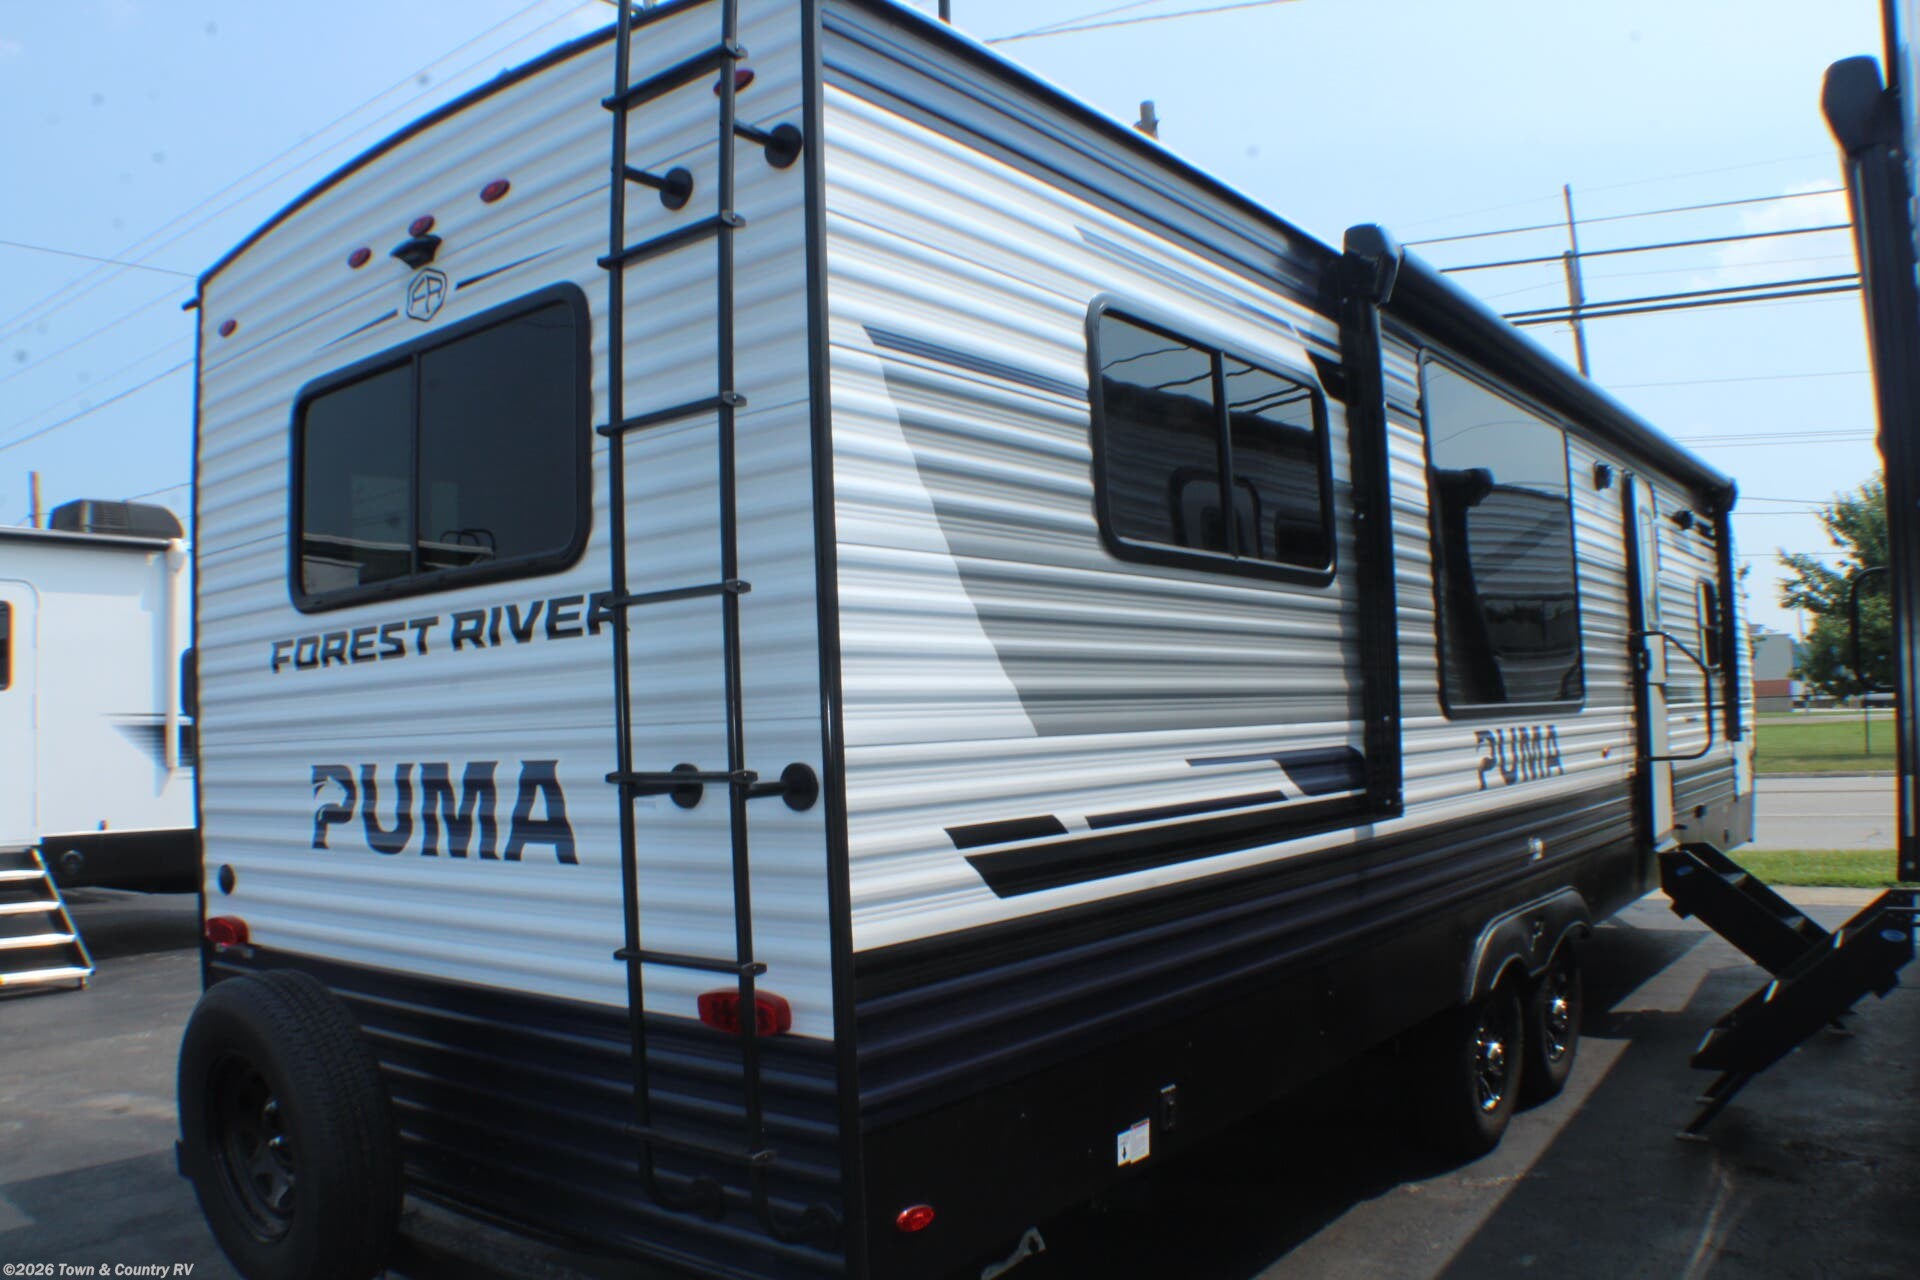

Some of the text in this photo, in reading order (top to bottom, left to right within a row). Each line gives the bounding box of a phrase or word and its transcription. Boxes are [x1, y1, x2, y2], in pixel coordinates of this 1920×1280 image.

[271, 616, 439, 673] FOREST
[1474, 724, 1564, 790] PUMA
[311, 759, 579, 865] PUMA
